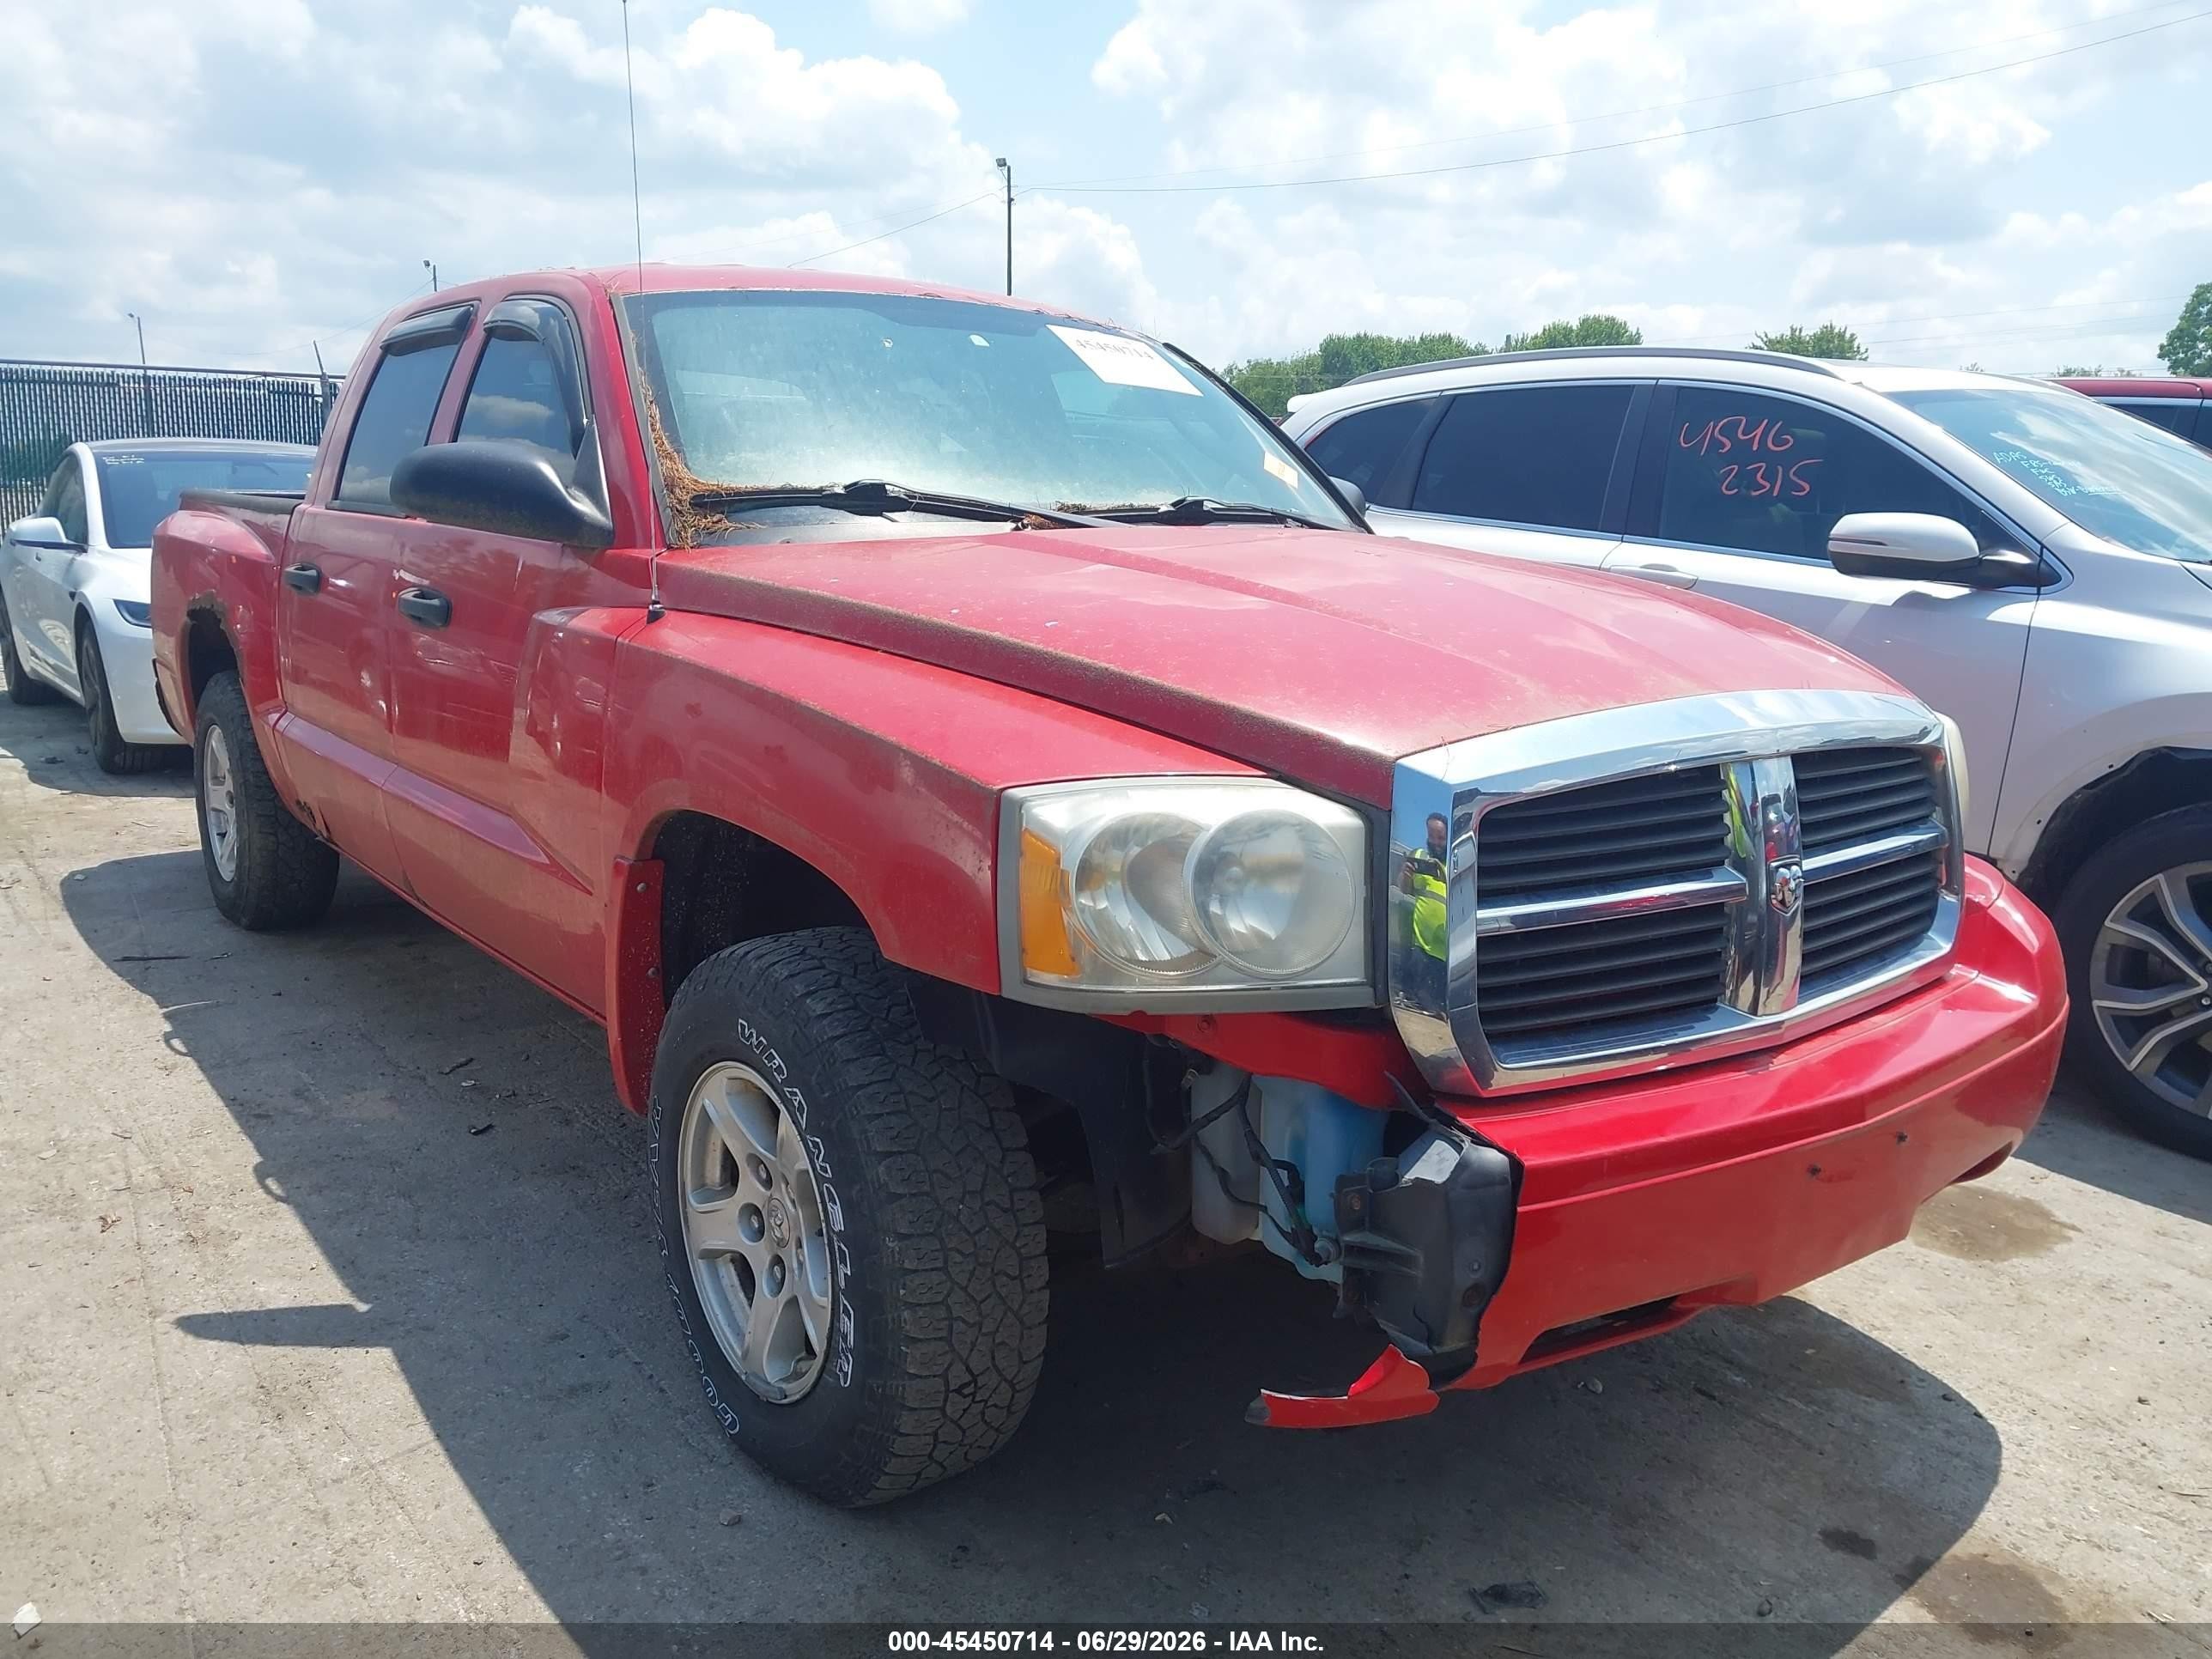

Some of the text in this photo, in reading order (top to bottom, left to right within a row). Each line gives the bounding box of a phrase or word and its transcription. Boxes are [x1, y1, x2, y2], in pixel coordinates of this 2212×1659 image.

[1680, 416, 1794, 456] 4546
[1720, 459, 1824, 497] 2315
[738, 1018, 854, 1389] WRANGLER
